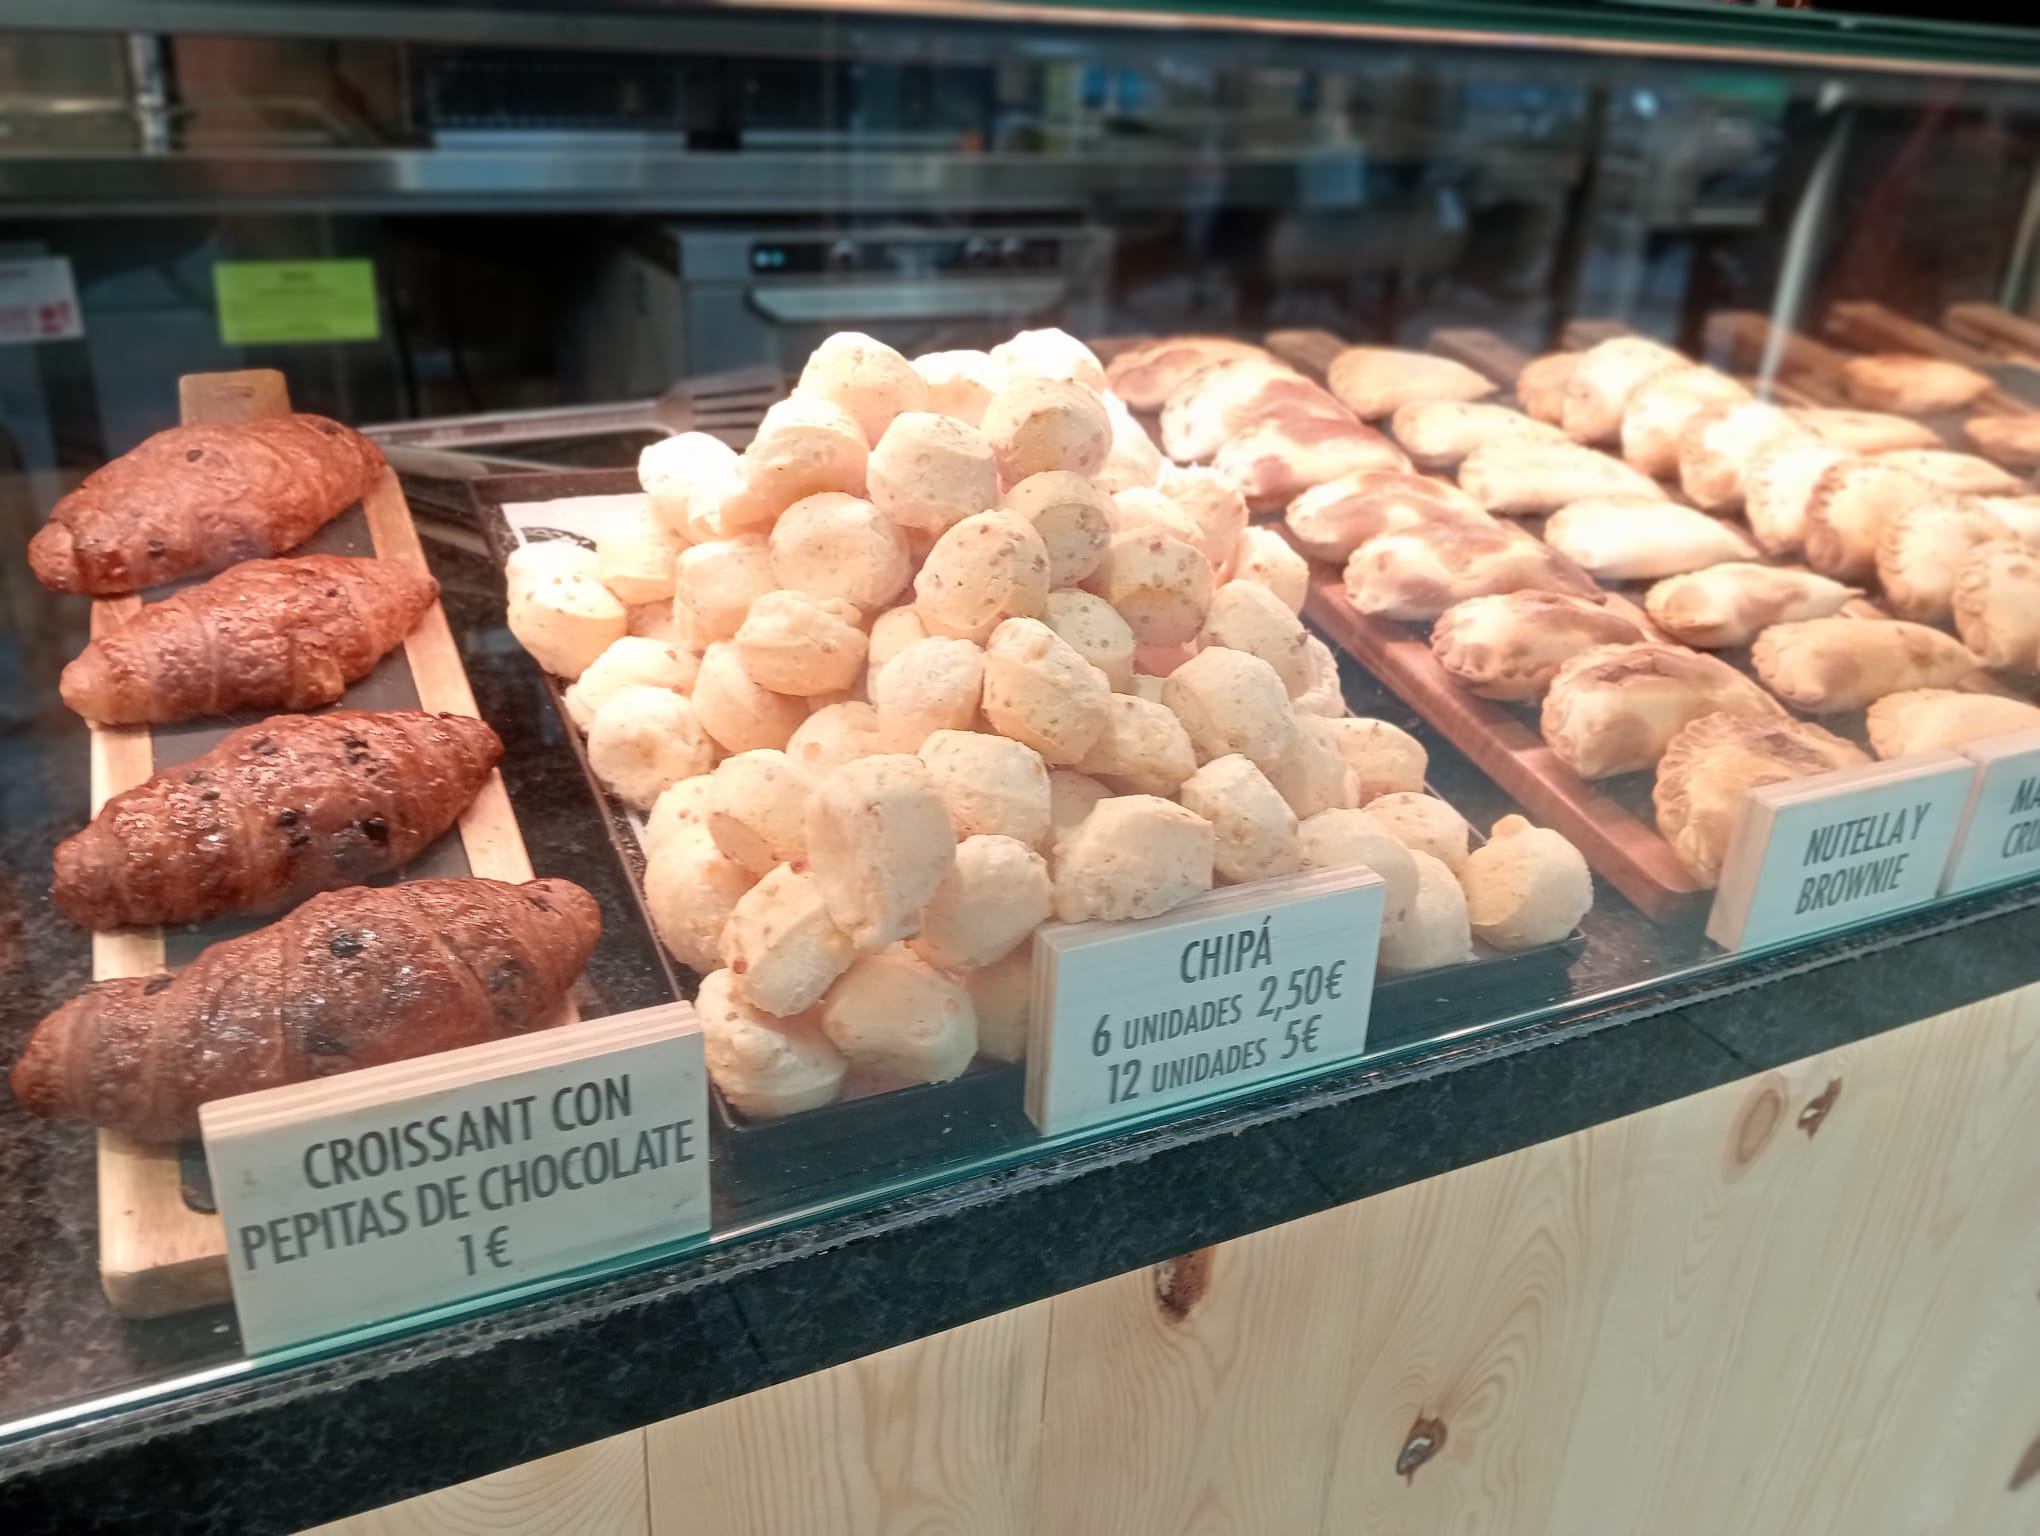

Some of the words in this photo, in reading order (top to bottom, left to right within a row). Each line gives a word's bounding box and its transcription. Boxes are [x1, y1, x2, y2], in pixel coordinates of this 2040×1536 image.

[1802, 808, 1907, 867] NUTELLA
[1910, 802, 1932, 841] Y
[1795, 853, 1910, 915] BROWNIE
[1180, 915, 1272, 984] CHIPÁ
[1092, 1014, 1111, 1057] 6
[1123, 994, 1243, 1050] UNIDADES
[1256, 960, 1346, 1022] 2,50€
[1108, 1059, 1142, 1104] 12
[1152, 1037, 1267, 1093] UNIDADES
[1280, 1014, 1323, 1060] 5€
[304, 1095, 536, 1189] CROISSANT
[552, 1073, 632, 1132] CON
[240, 1189, 409, 1271] PEPITAS
[417, 1174, 470, 1228] DE
[479, 1119, 694, 1211] CHOCOLATE
